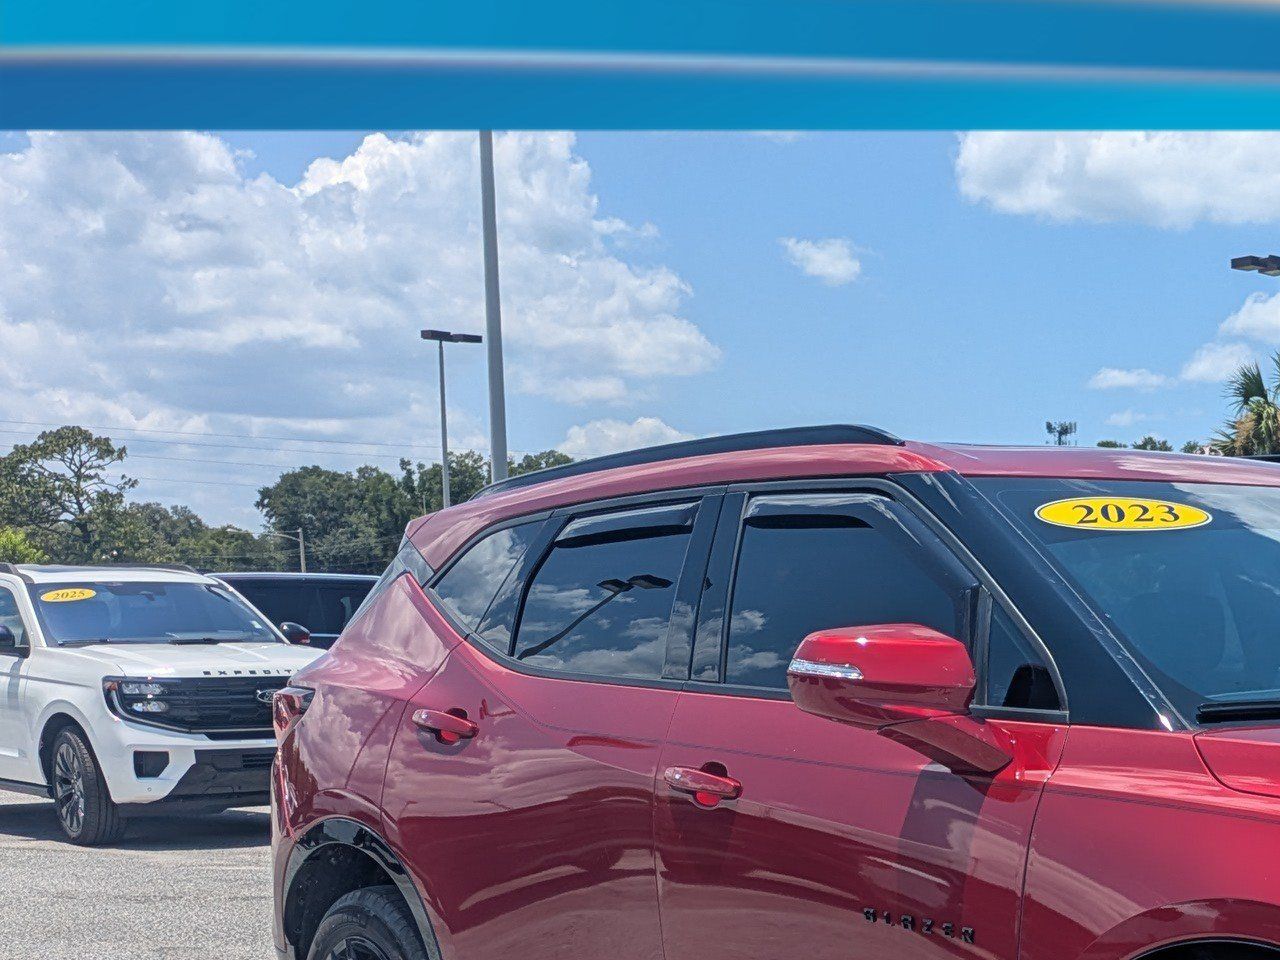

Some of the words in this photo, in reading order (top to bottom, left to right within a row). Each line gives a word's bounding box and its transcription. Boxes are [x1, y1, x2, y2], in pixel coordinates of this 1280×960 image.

[1072, 503, 1181, 525] 2023
[53, 591, 85, 600] 2025
[863, 907, 975, 944] BLAZER
